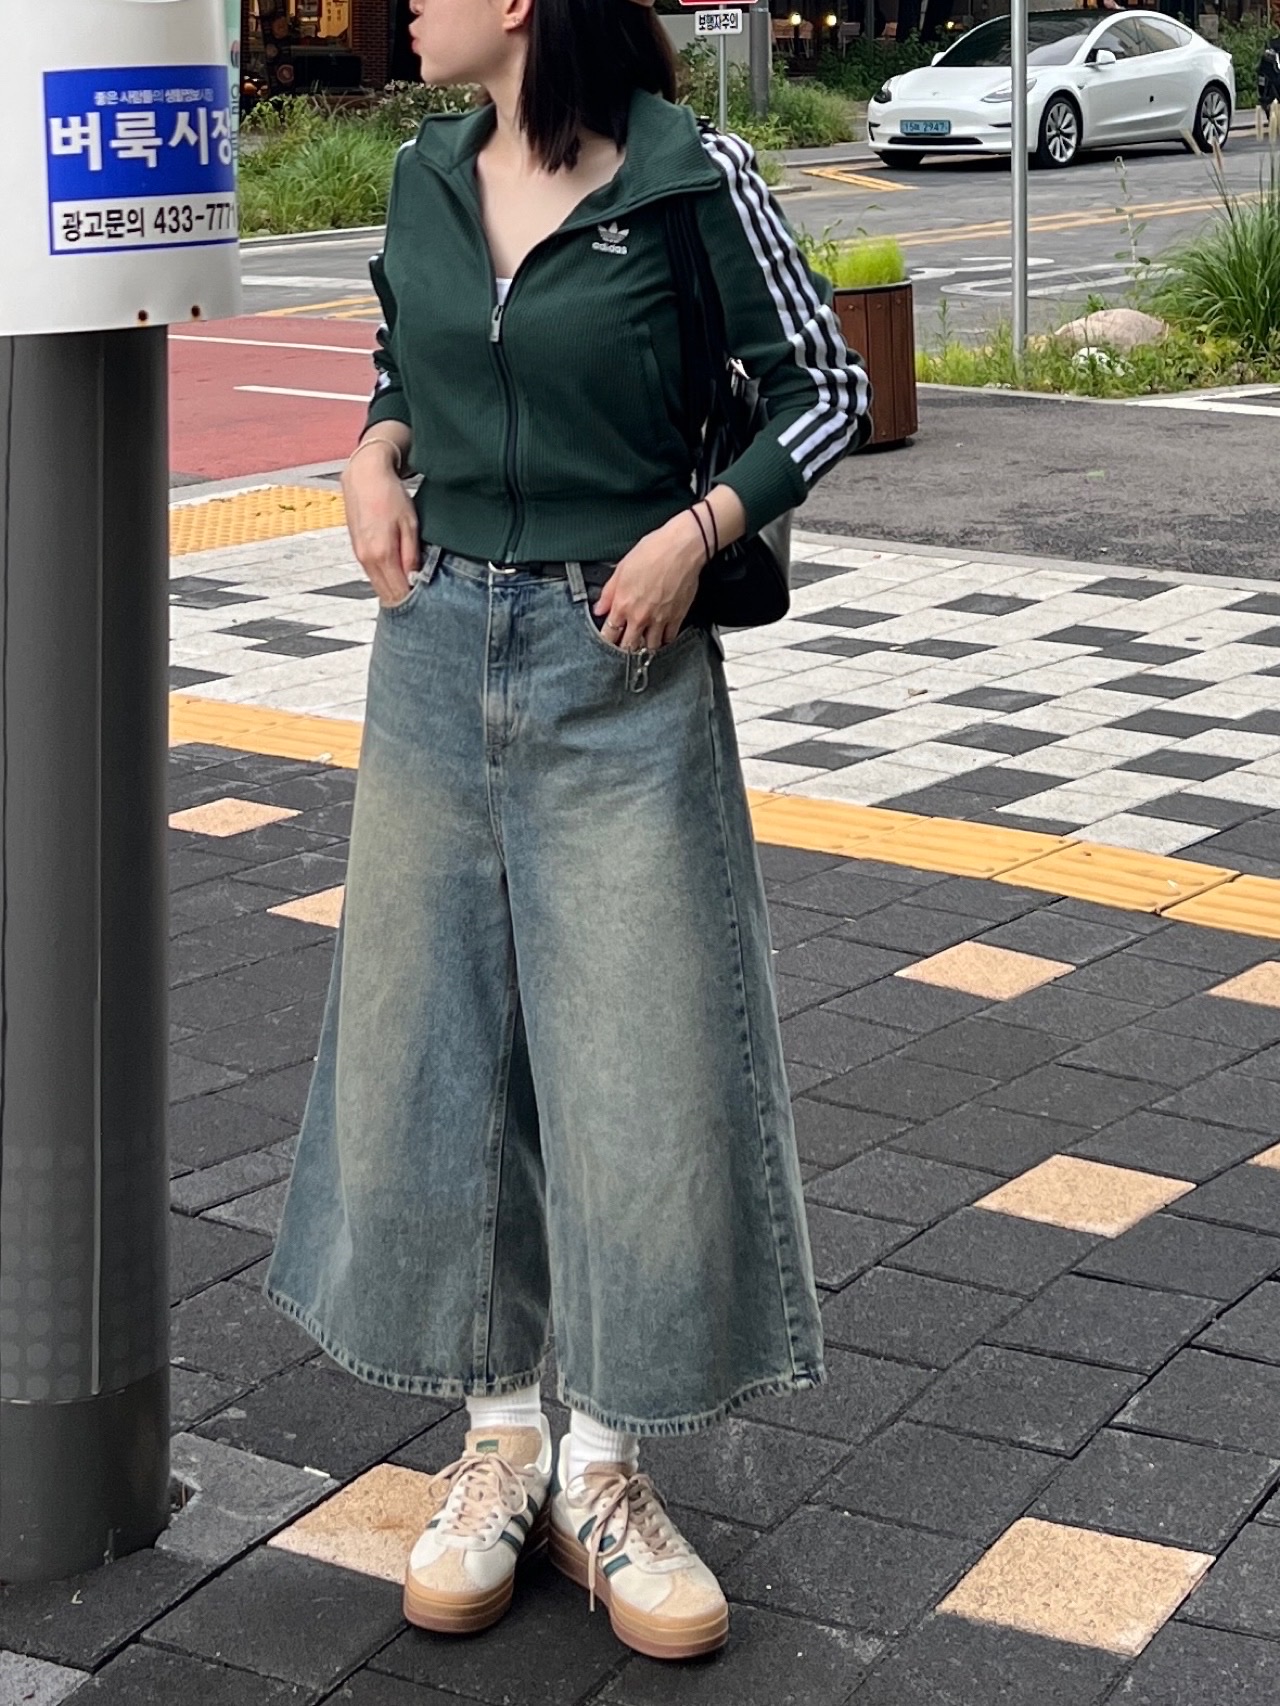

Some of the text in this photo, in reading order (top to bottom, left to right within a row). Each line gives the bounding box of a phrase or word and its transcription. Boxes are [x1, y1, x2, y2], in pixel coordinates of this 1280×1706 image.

[698, 13, 738, 31] 보행자주의
[49, 107, 231, 171] 벼룩시장
[63, 207, 145, 242] 광고문의
[592, 242, 627, 255] adidas
